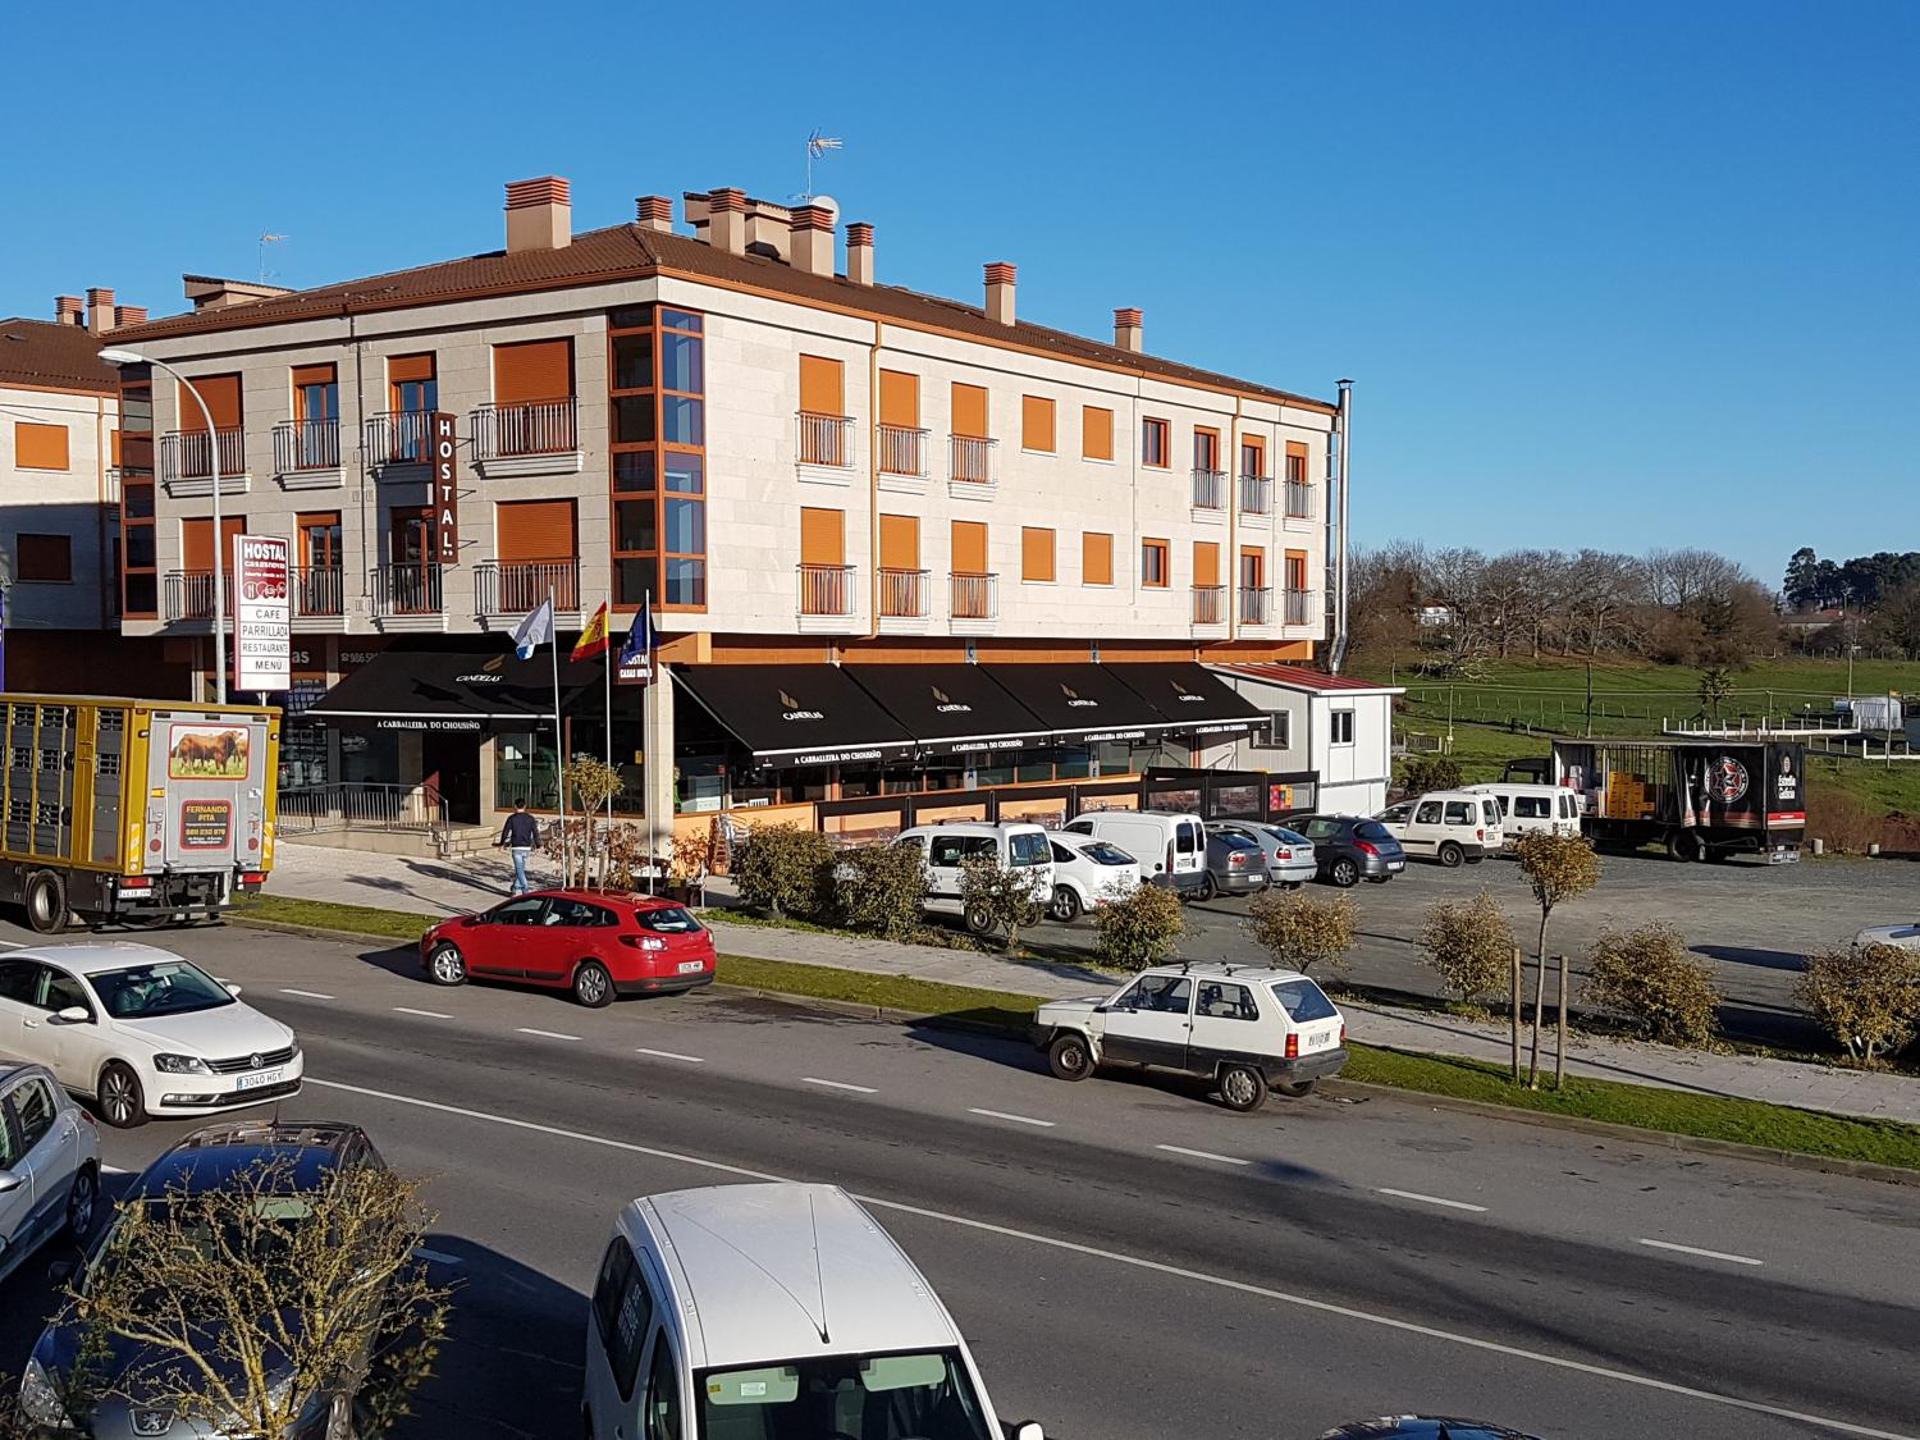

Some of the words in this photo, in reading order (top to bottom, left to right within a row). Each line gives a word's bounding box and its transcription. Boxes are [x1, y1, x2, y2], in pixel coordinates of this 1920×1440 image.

[439, 420, 453, 548] HOSTAL
[244, 543, 285, 560] HOSTAL
[242, 625, 288, 637] PARRILLADA
[242, 643, 288, 653] RESTAURANTE
[430, 721, 442, 729] DO
[794, 756, 800, 765] A
[841, 752, 850, 761] DO
[186, 805, 228, 813] FERNANDO
[198, 814, 216, 822] PITA
[244, 1075, 265, 1087] 3040
